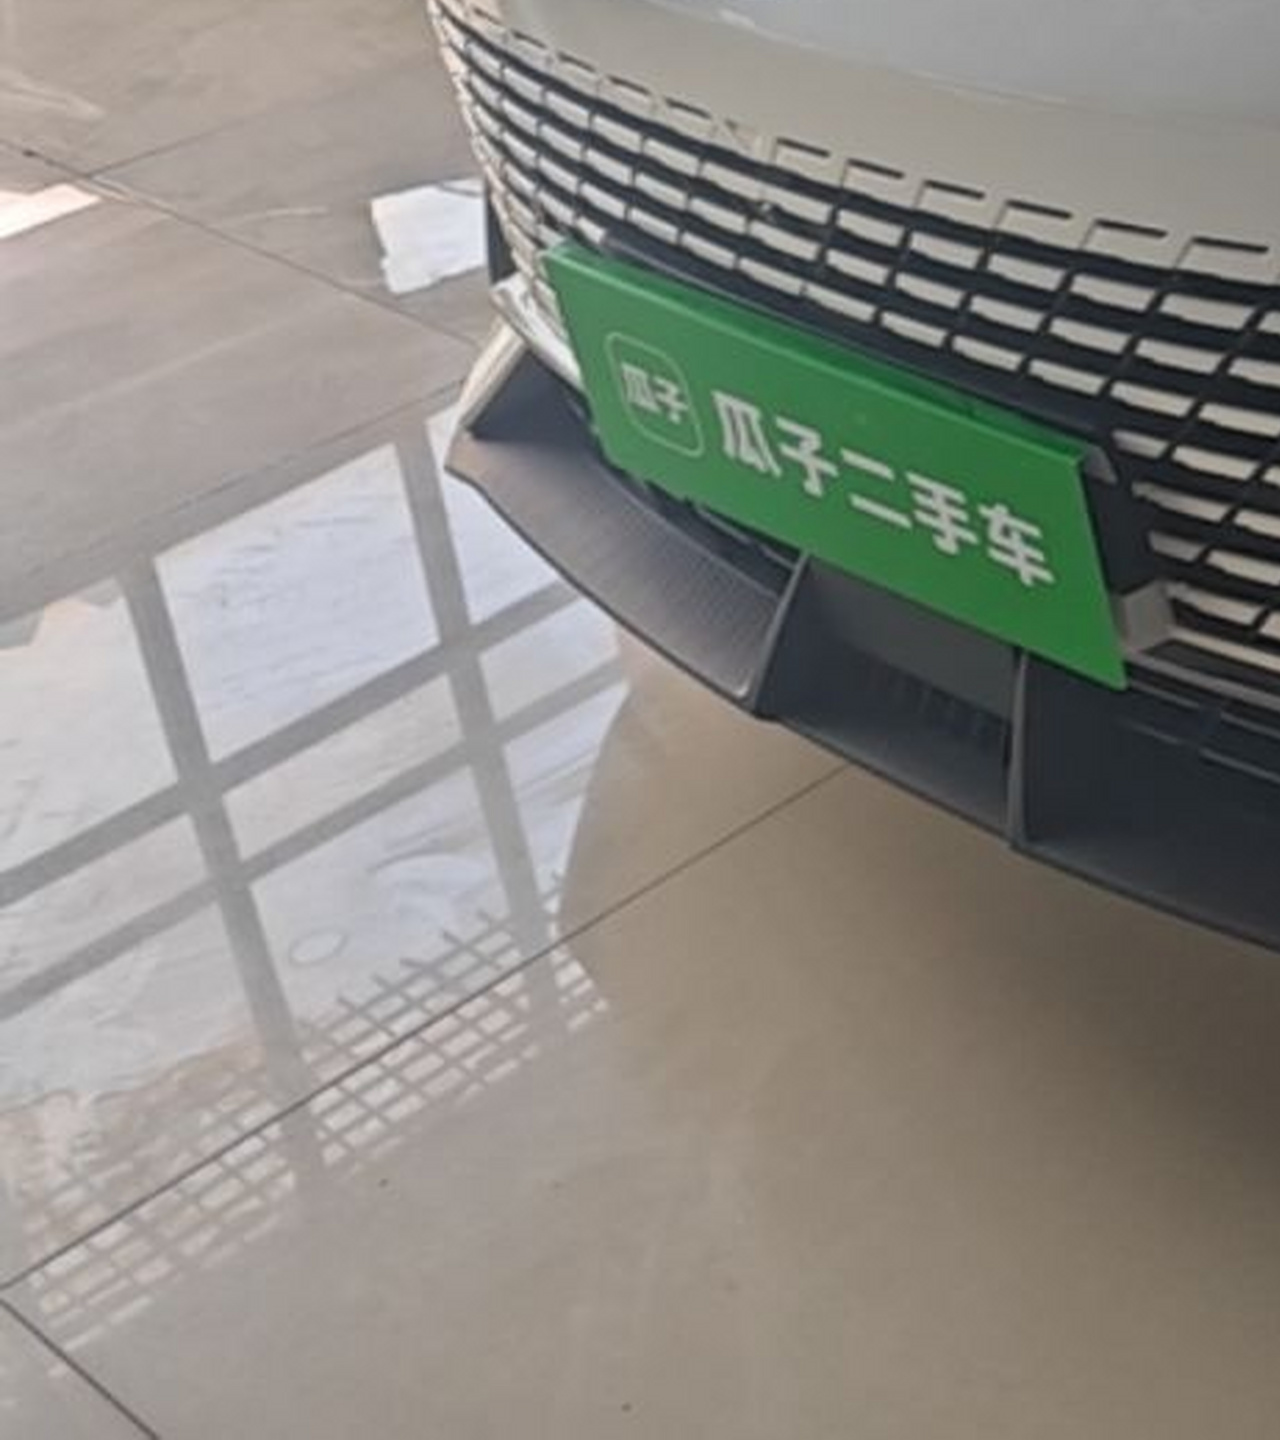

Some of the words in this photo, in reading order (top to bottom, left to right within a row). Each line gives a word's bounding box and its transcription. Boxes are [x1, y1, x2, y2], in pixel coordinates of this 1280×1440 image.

[620, 362, 688, 425] 瓜子
[711, 389, 1055, 586] 瓜子二手车
